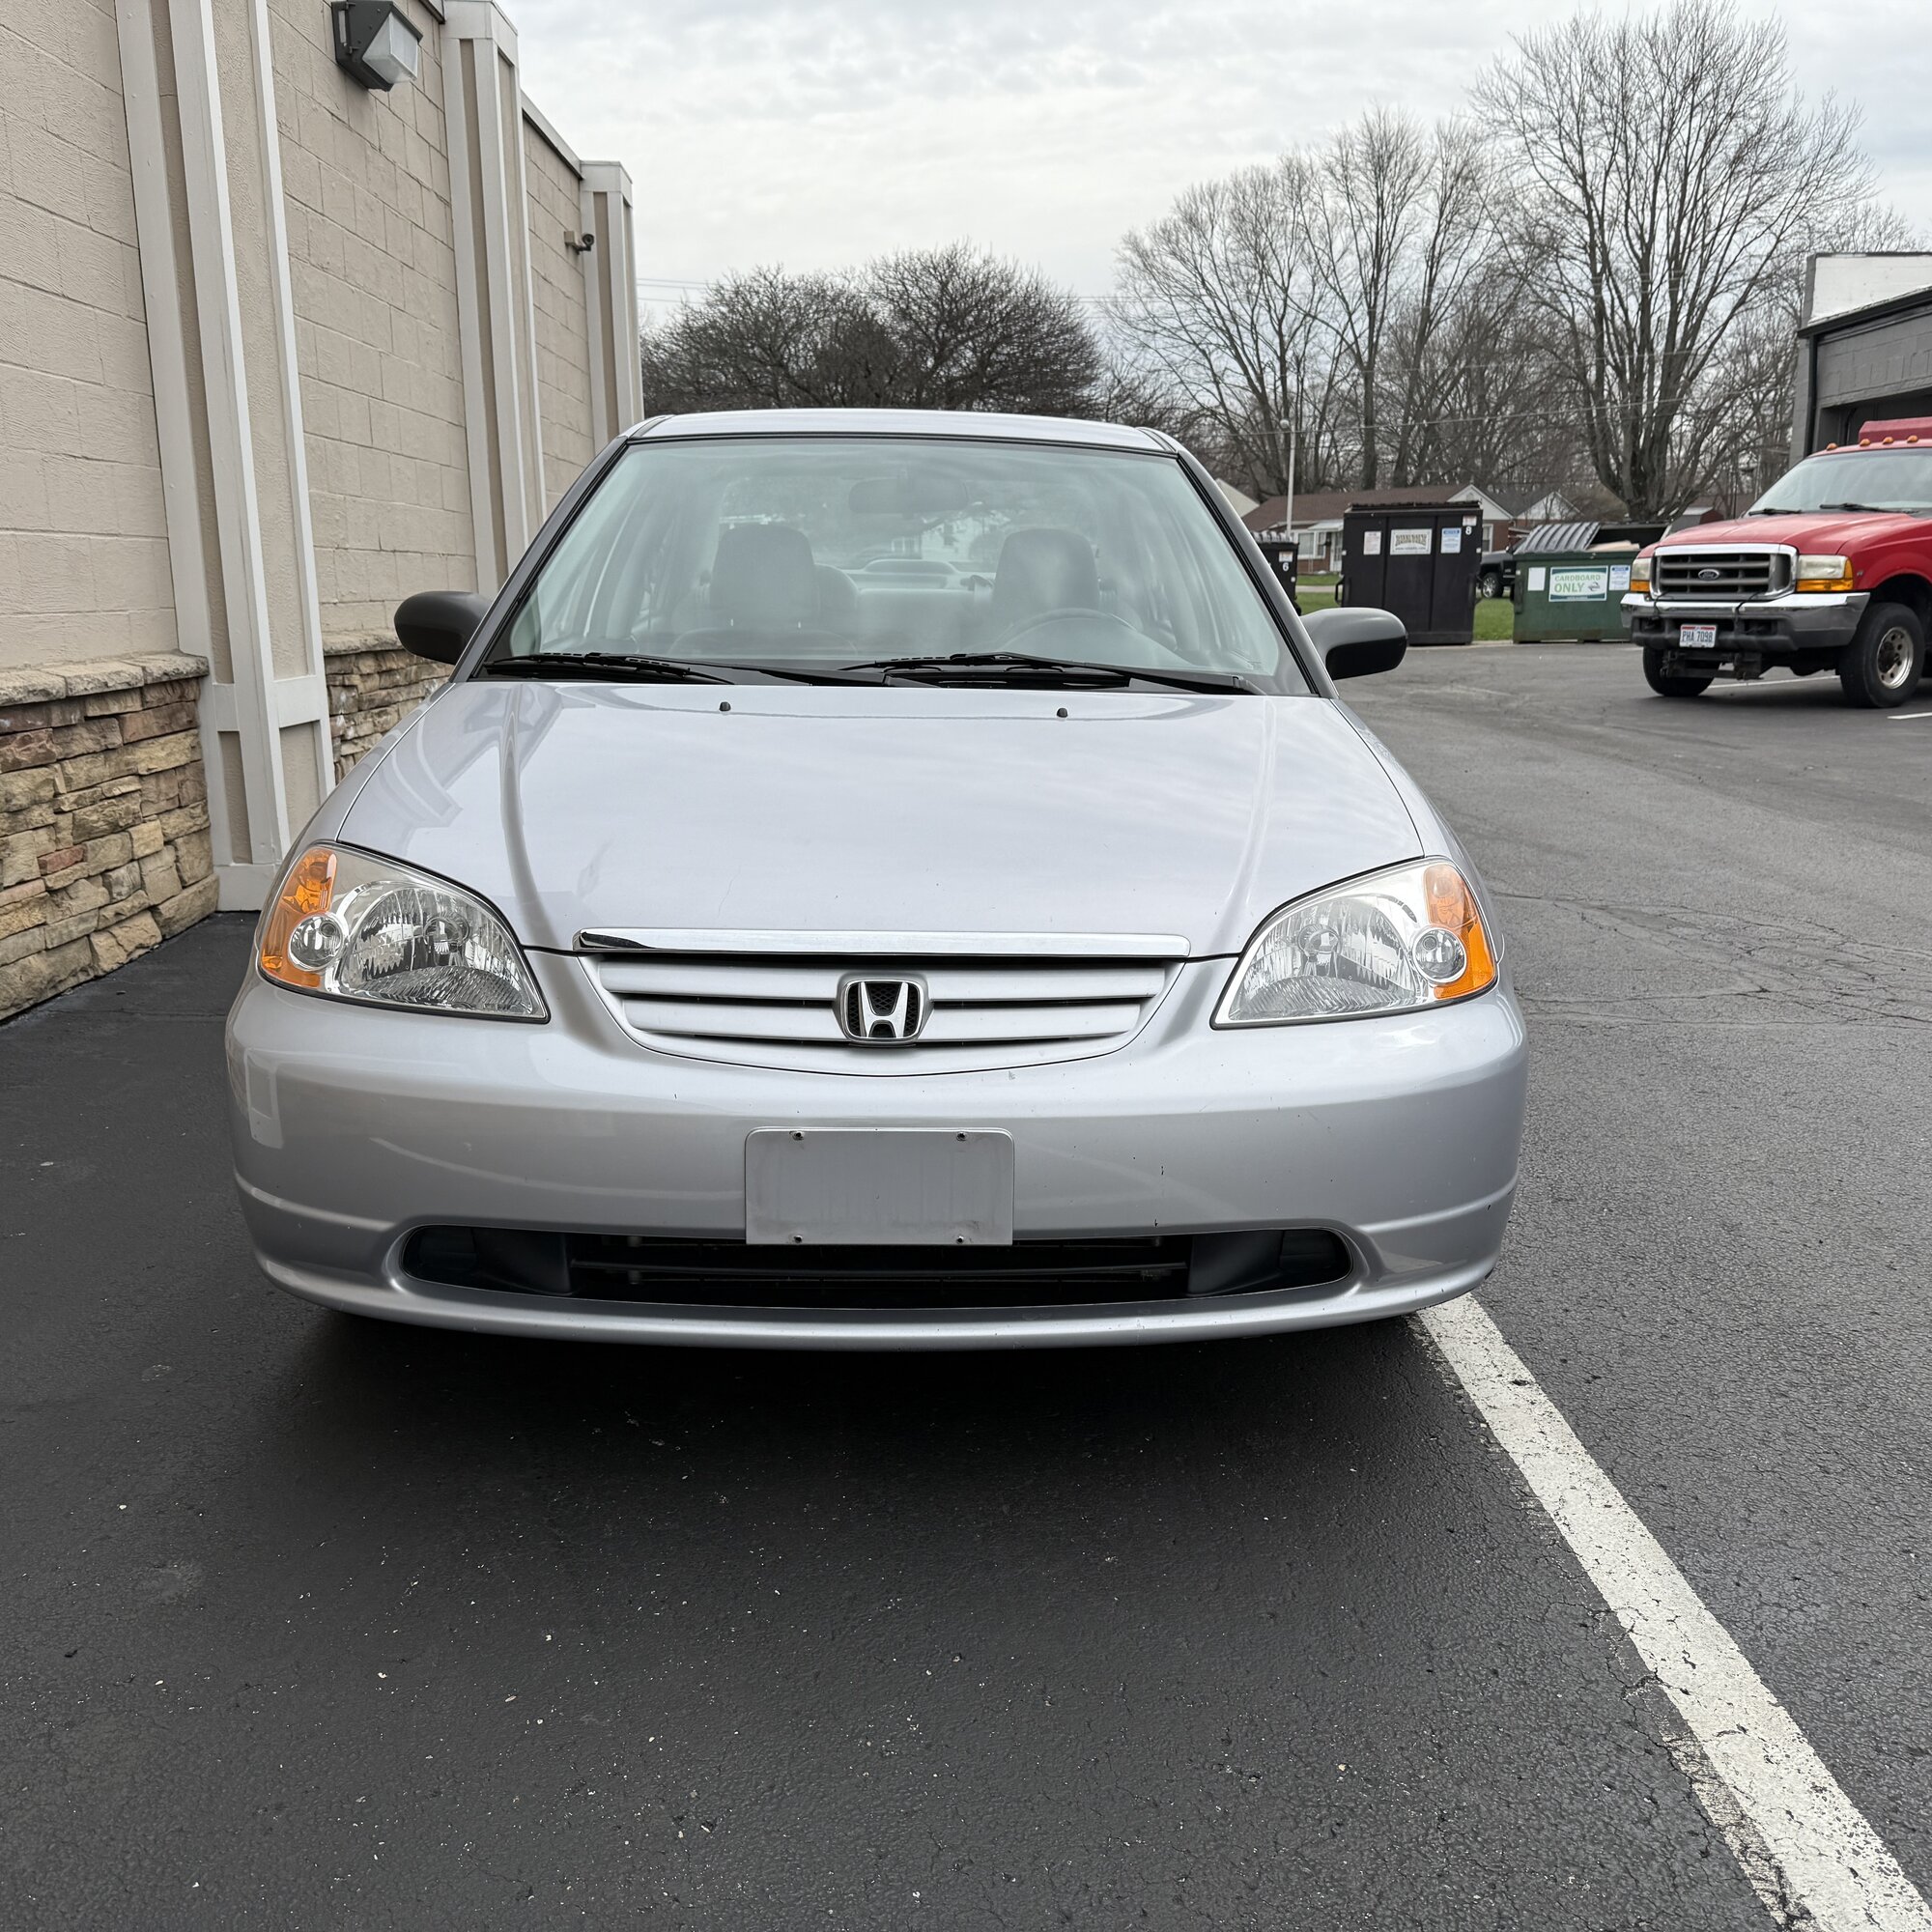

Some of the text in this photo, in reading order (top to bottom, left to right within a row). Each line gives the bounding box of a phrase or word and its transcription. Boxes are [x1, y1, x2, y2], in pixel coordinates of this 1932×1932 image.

[1465, 526, 1472, 535] 8
[1282, 562, 1290, 572] 6
[1554, 583, 1585, 593] ONLY
[1682, 631, 1694, 642] PHA
